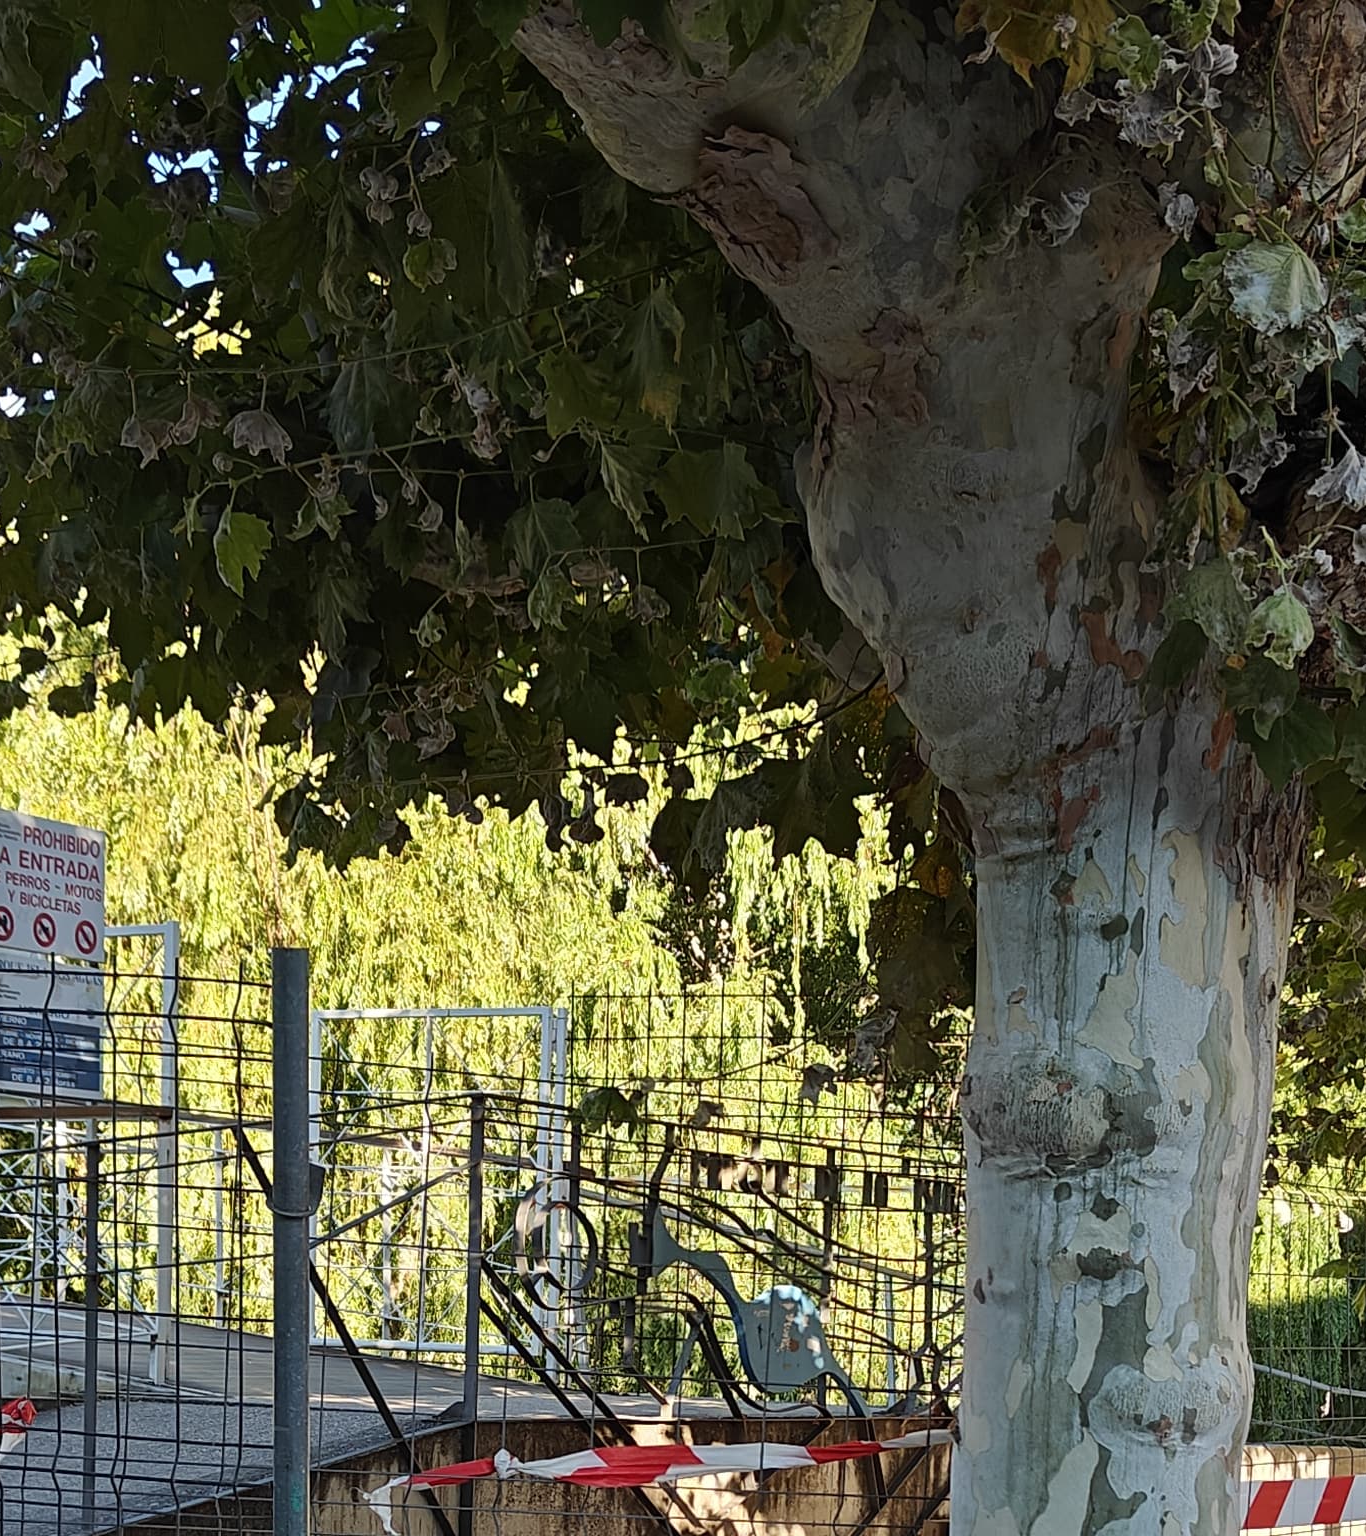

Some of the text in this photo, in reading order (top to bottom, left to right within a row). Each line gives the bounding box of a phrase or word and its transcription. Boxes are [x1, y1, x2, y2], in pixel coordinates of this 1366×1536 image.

[23, 826, 101, 858] PROHIBIDO
[19, 850, 100, 883] ENTRADA
[5, 871, 51, 892] PERROS
[65, 883, 102, 903] MOTOS
[7, 889, 81, 915] Y BICICLETAS
[11, 1073, 24, 1082] DE
